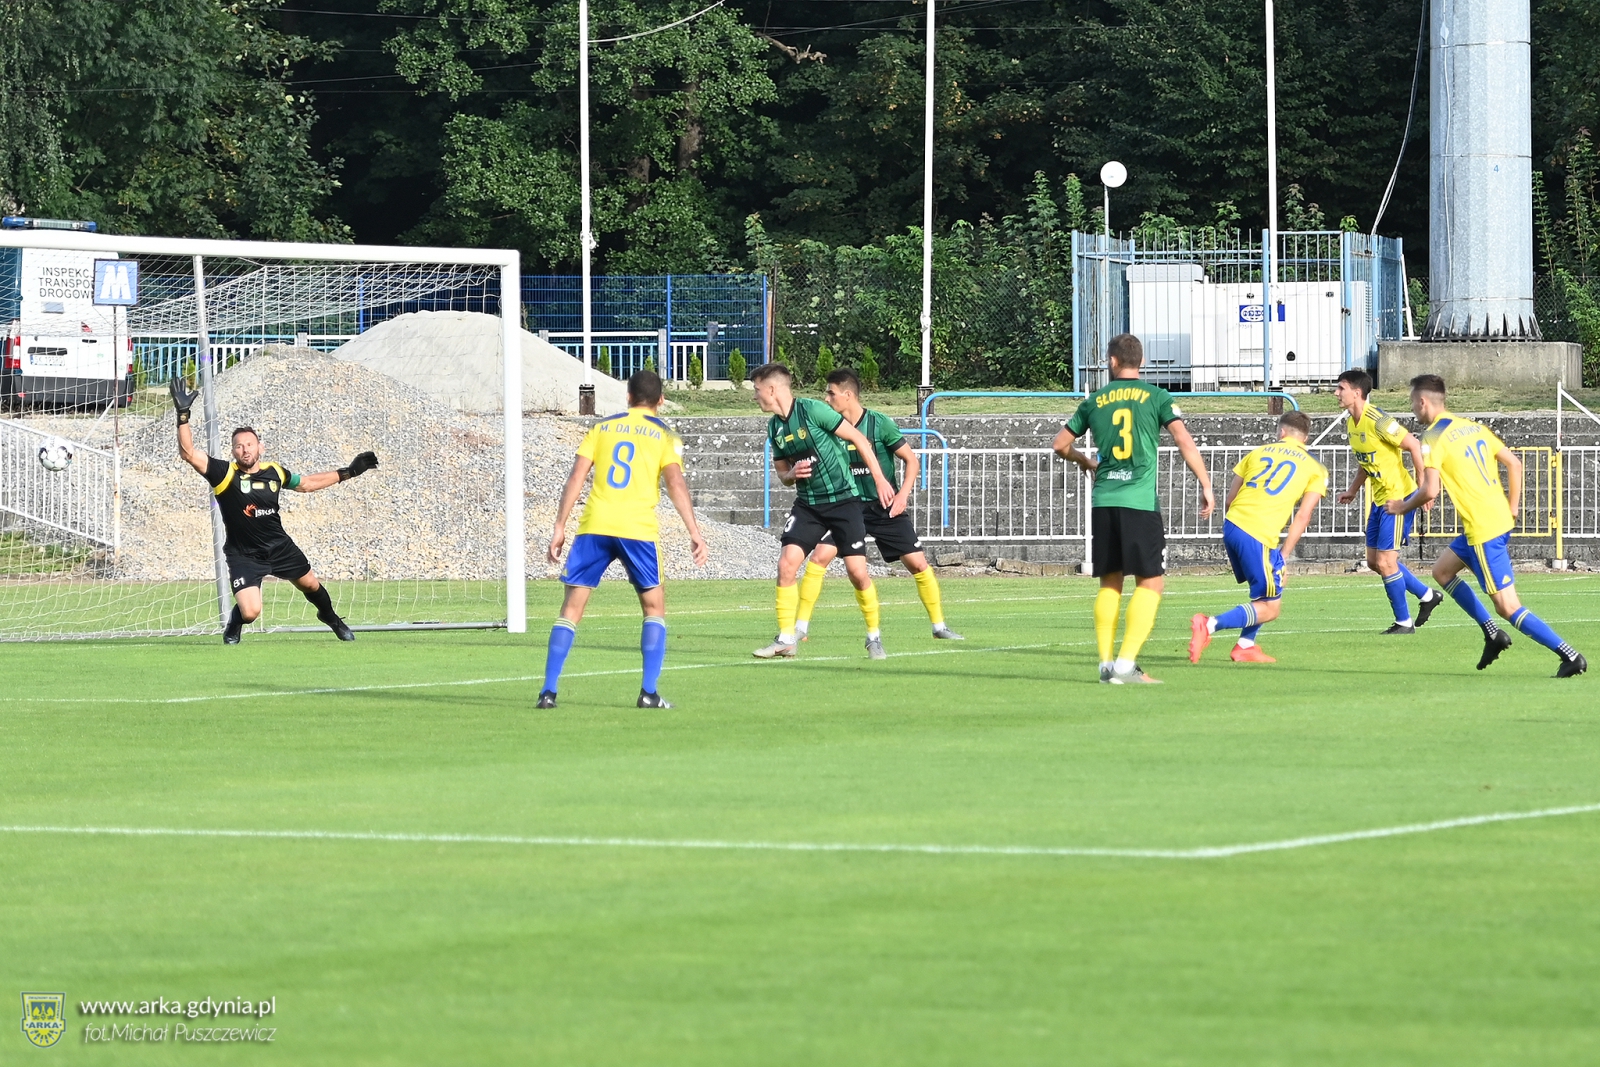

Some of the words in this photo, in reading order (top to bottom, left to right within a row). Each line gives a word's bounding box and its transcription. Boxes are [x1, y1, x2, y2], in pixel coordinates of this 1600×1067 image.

[42, 266, 94, 279] INSPEKC
[39, 277, 94, 290] TRANSPO
[1095, 387, 1150, 408] SŁODOWY
[600, 423, 611, 433] M.
[615, 423, 631, 434] DA
[633, 424, 661, 441] SILVA
[1112, 407, 1133, 461] 3
[607, 440, 636, 490] 8
[1246, 456, 1297, 496] 20
[233, 576, 245, 588] 81
